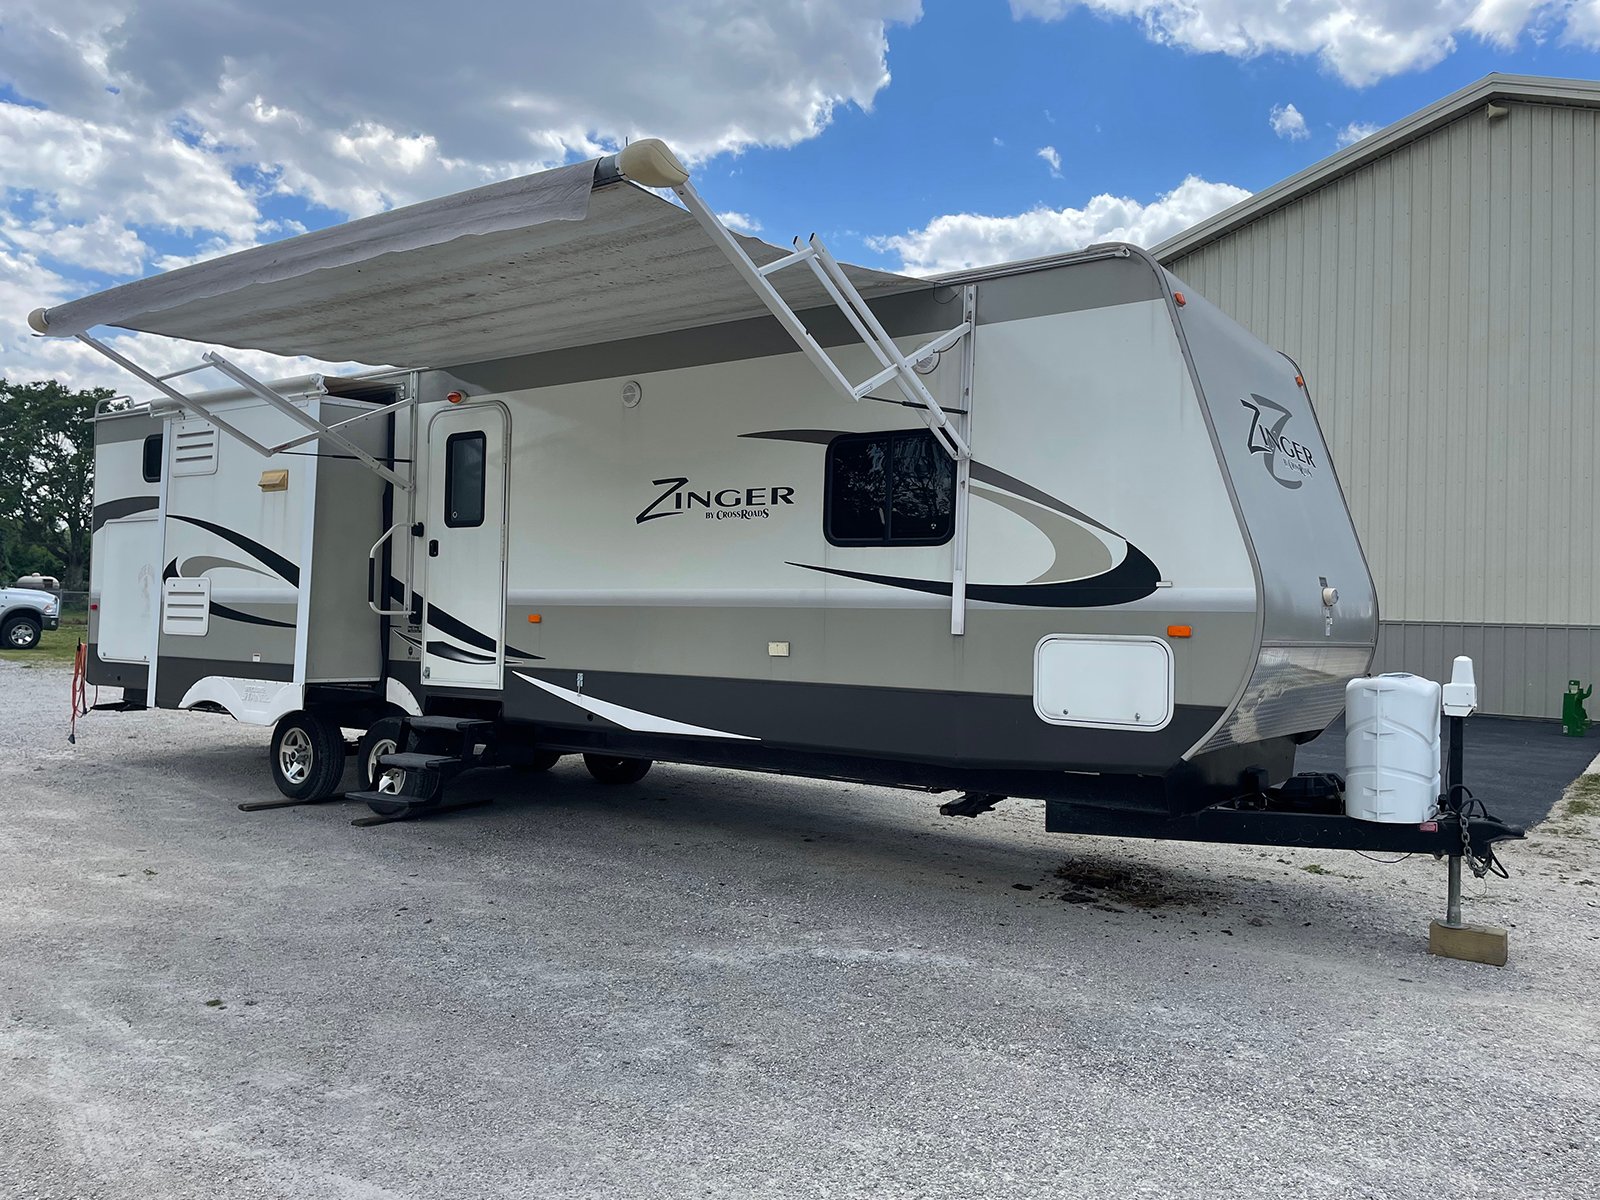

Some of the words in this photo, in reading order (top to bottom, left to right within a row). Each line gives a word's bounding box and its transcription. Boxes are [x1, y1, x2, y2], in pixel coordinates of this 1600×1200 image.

[1240, 398, 1317, 469] ZINGER
[635, 477, 795, 525] ZINGER
[705, 511, 715, 520] BY
